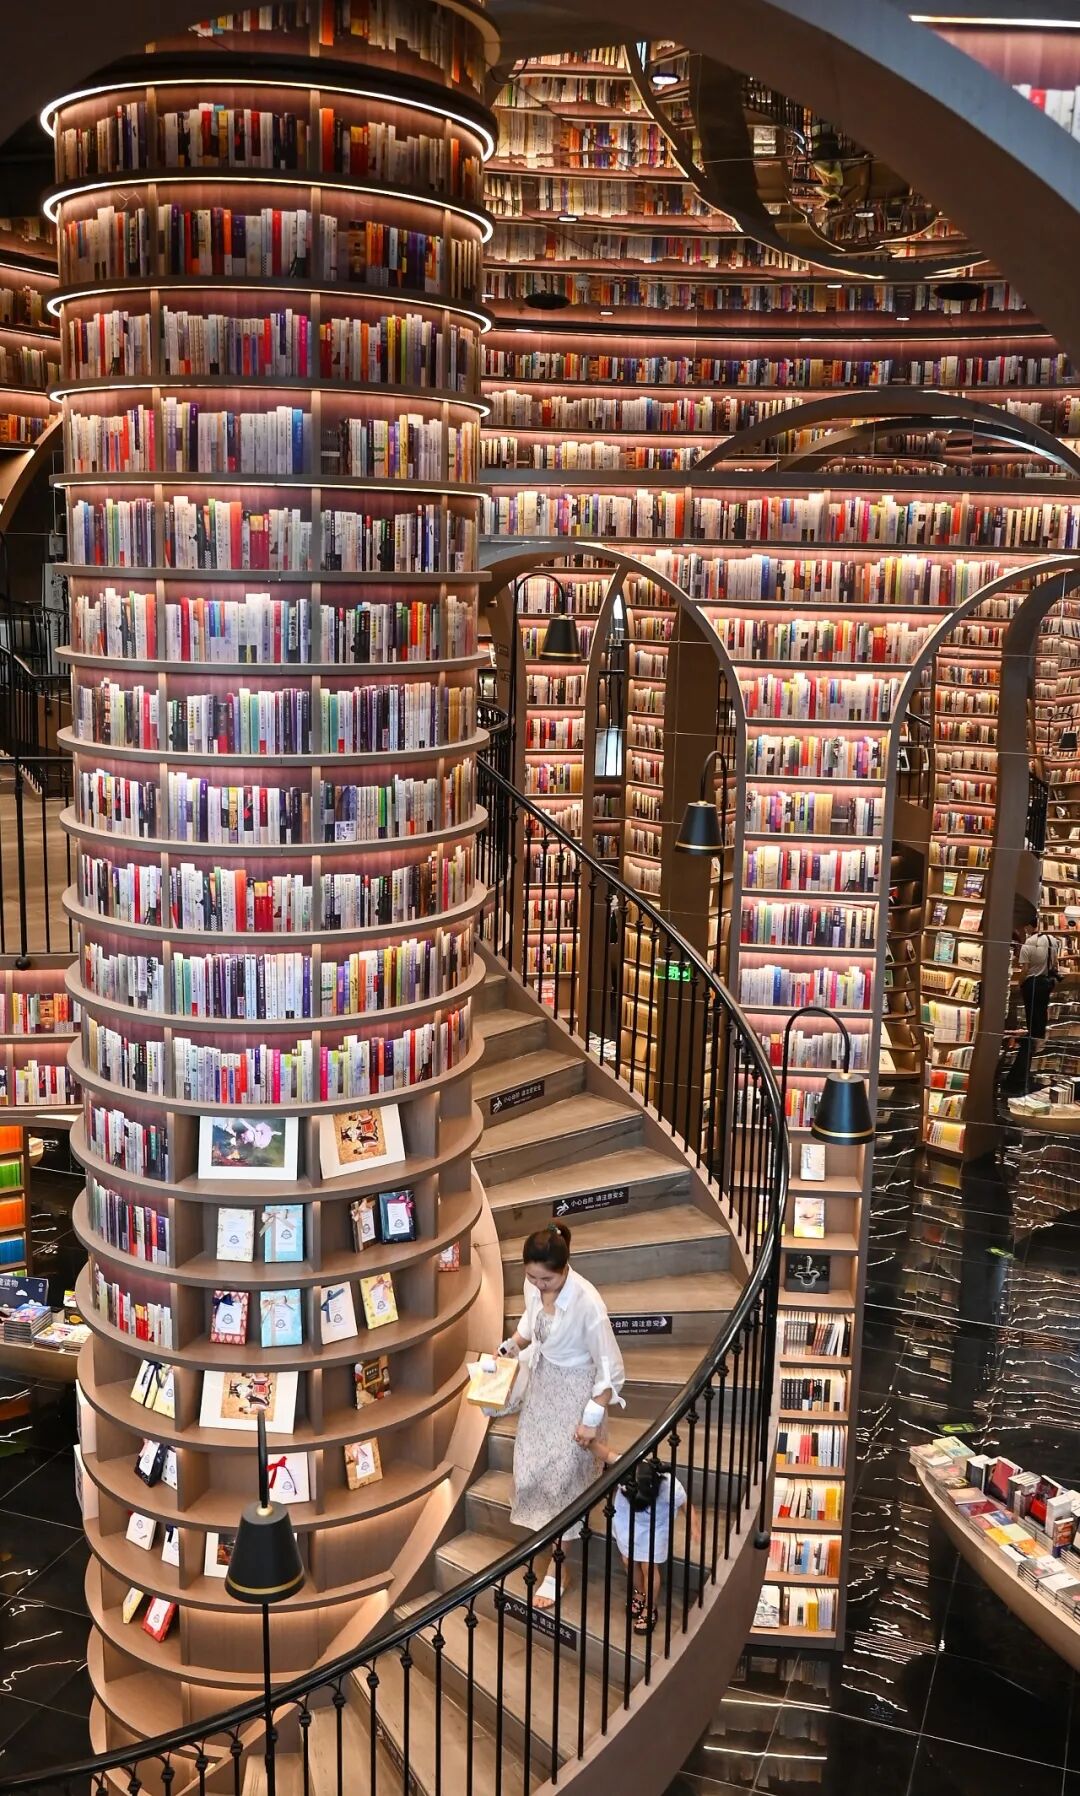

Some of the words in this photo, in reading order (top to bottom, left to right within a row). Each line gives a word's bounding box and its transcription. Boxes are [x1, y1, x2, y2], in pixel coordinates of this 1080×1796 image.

[570, 1196, 594, 1207] 小心台阶
[595, 1191, 624, 1202] 请注意安全
[512, 1603, 538, 1621] 小心阶
